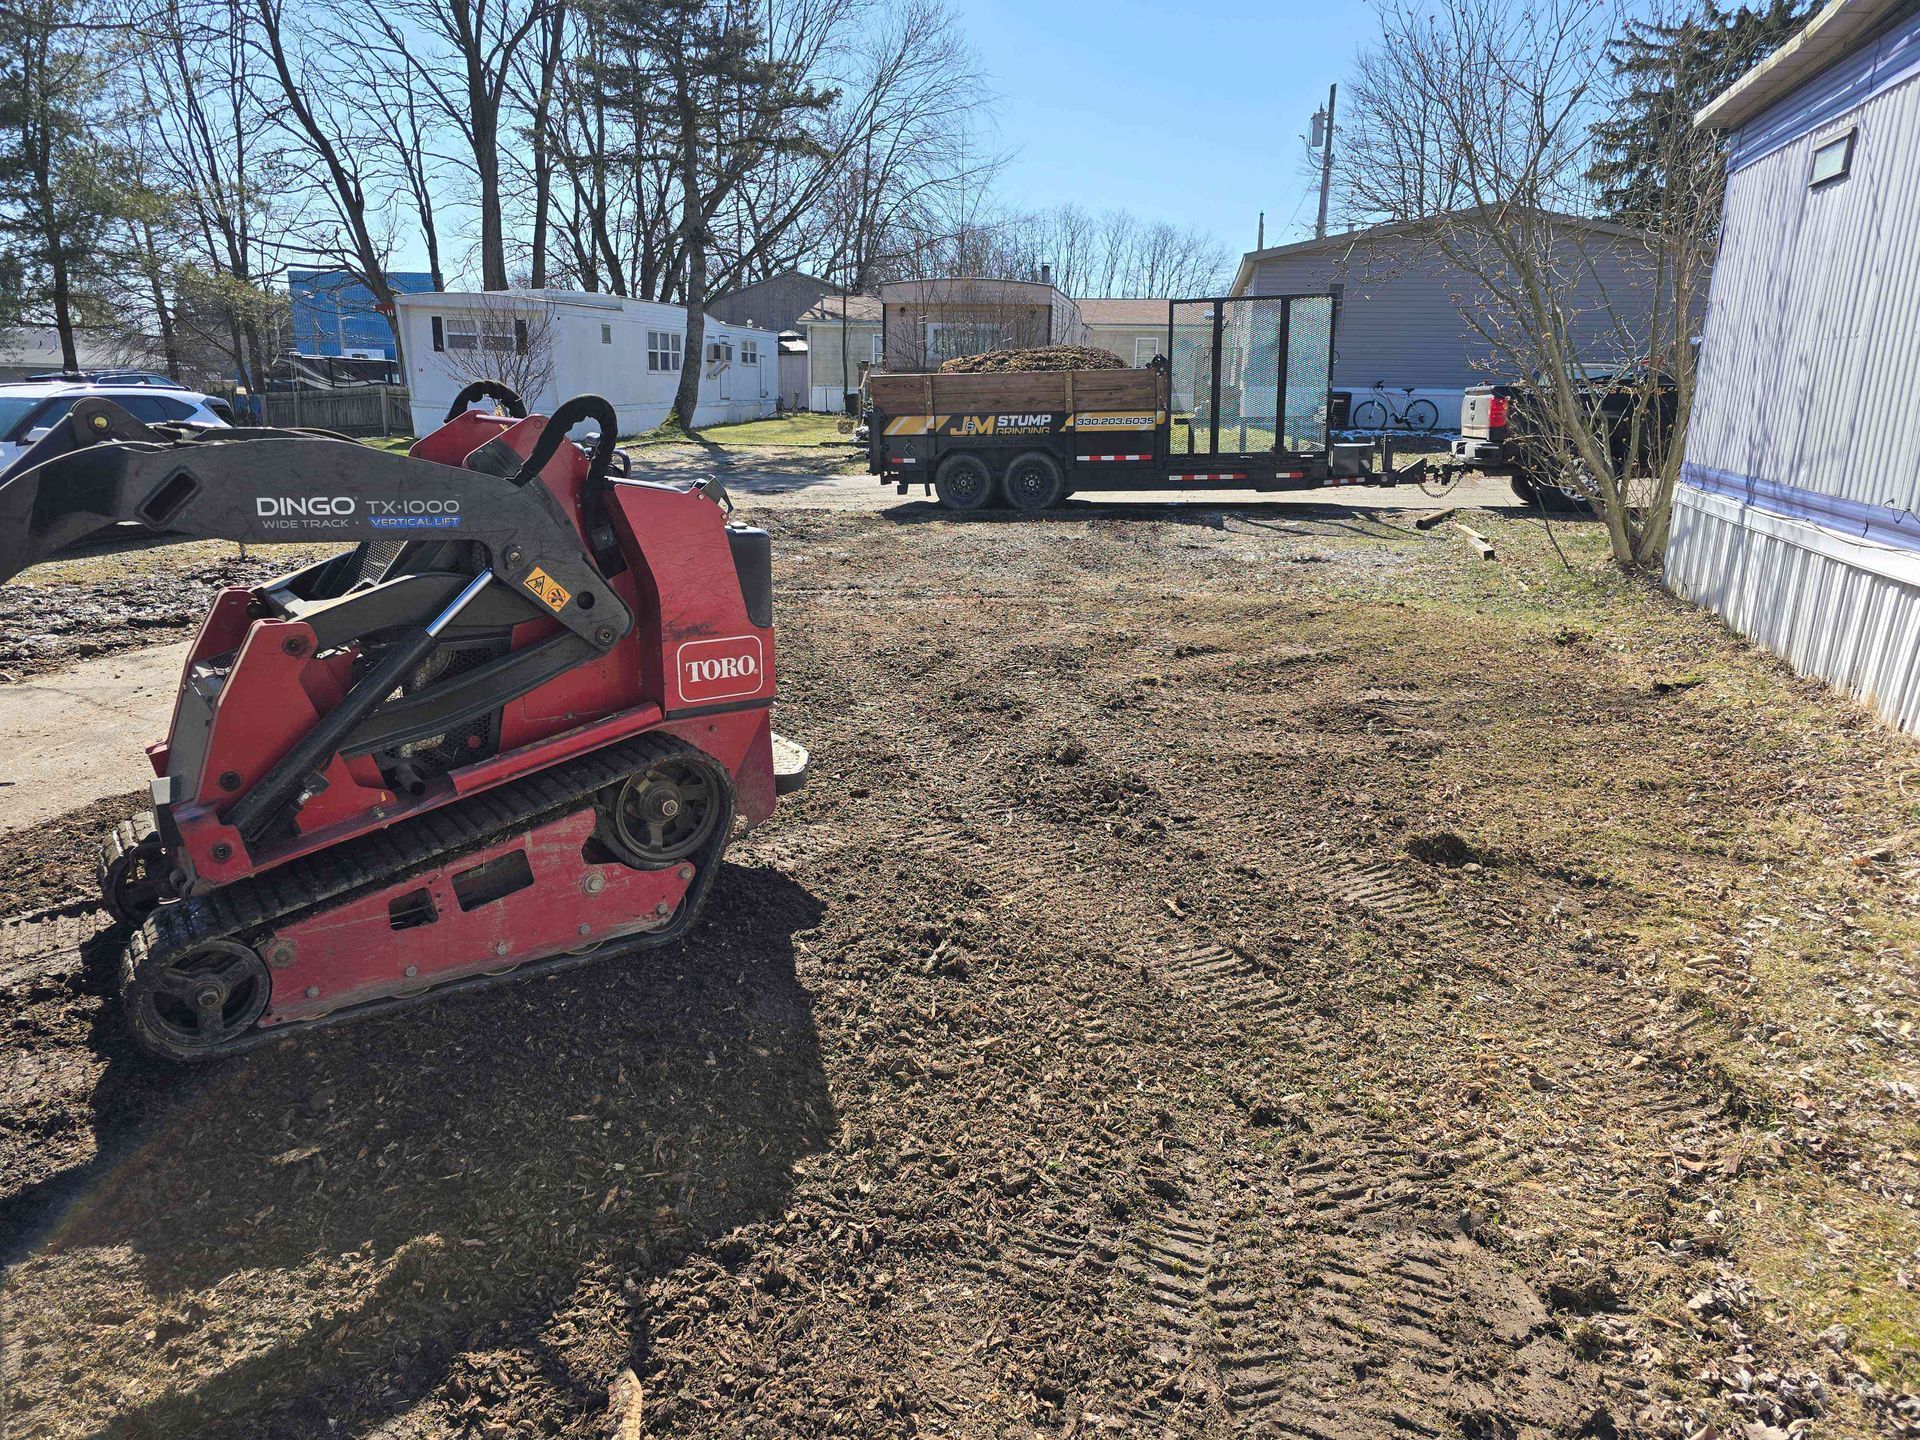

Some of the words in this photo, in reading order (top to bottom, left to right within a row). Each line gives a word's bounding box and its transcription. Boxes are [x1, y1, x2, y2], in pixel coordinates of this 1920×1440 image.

[950, 415, 996, 436] J&M
[997, 414, 1052, 427] STUMP
[1076, 417, 1154, 426] 330.203.6035
[995, 426, 1050, 435] GRINDING
[256, 496, 356, 516] DINGO
[262, 519, 299, 529] WIDE
[301, 519, 349, 528] TRACK
[371, 518, 432, 527] VERTICAL
[435, 517, 459, 526] LIFT
[685, 655, 756, 683] TORO
